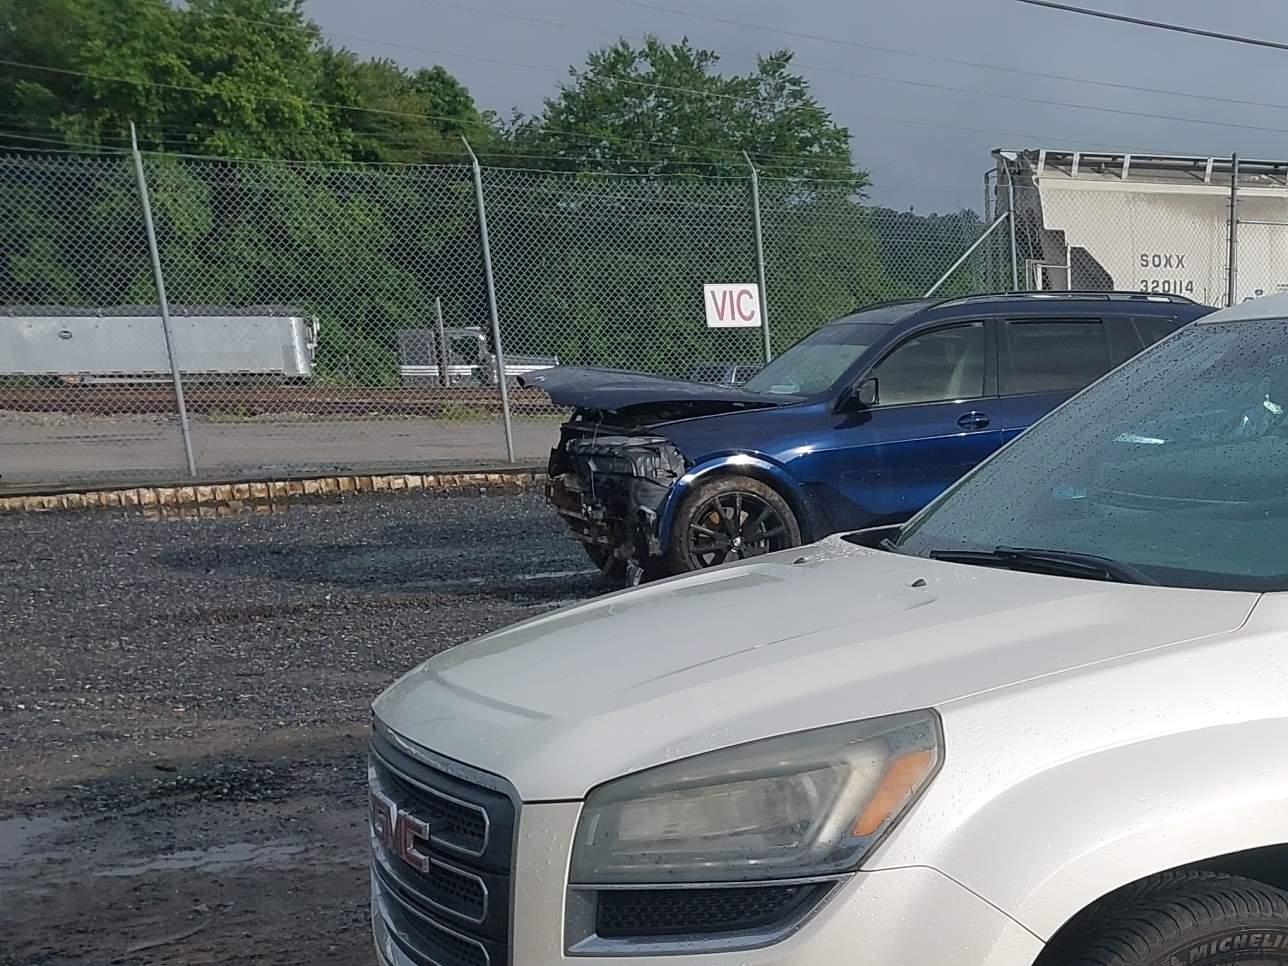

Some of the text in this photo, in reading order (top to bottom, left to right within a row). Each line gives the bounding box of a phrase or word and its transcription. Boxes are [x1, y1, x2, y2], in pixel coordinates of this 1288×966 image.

[1140, 253, 1185, 269] SOXX
[1140, 279, 1194, 293] 320114
[710, 289, 755, 321] VIC
